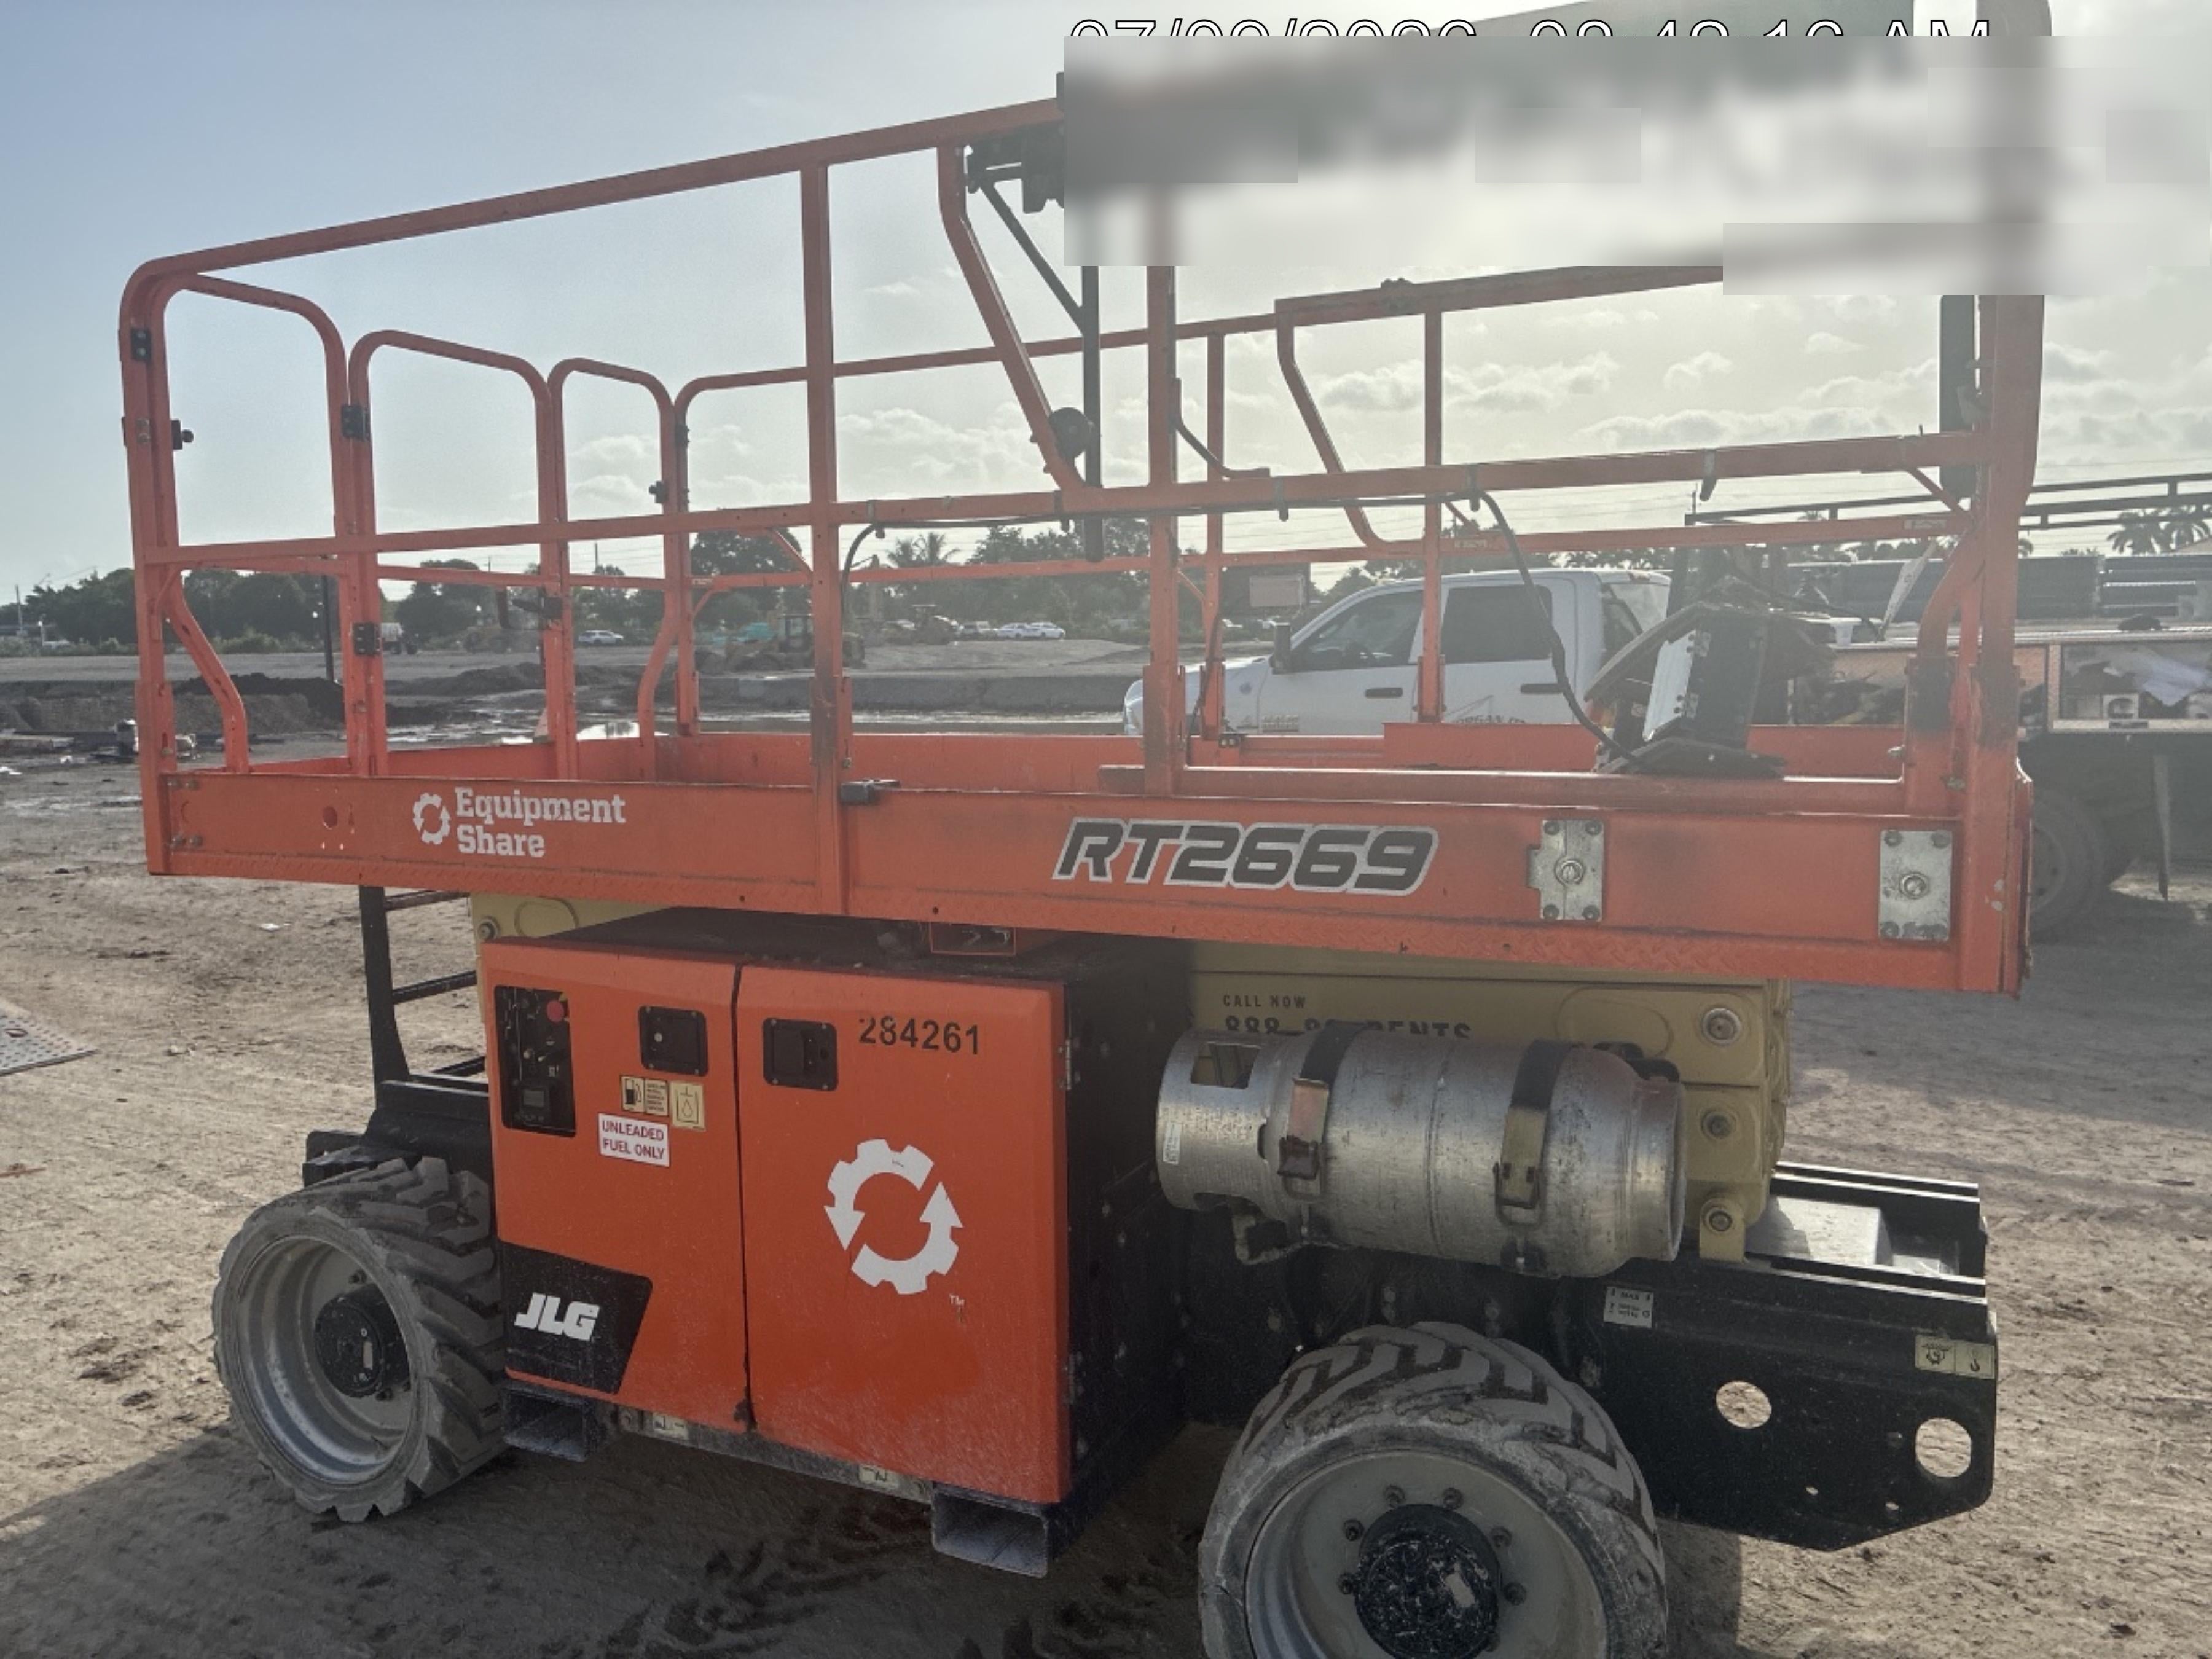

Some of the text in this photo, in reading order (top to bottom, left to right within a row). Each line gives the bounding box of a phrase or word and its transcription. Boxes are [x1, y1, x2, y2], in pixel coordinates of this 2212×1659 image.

[455, 787, 626, 826] Equipment
[457, 824, 546, 858] Share
[1051, 817, 1439, 896] RT2669
[1223, 994, 1306, 1009] CALL NOW
[858, 1016, 979, 1055] 284261
[603, 1120, 664, 1141] UNLEADED
[603, 1137, 665, 1160] FUEL ONLY
[514, 1292, 600, 1341] JLG
